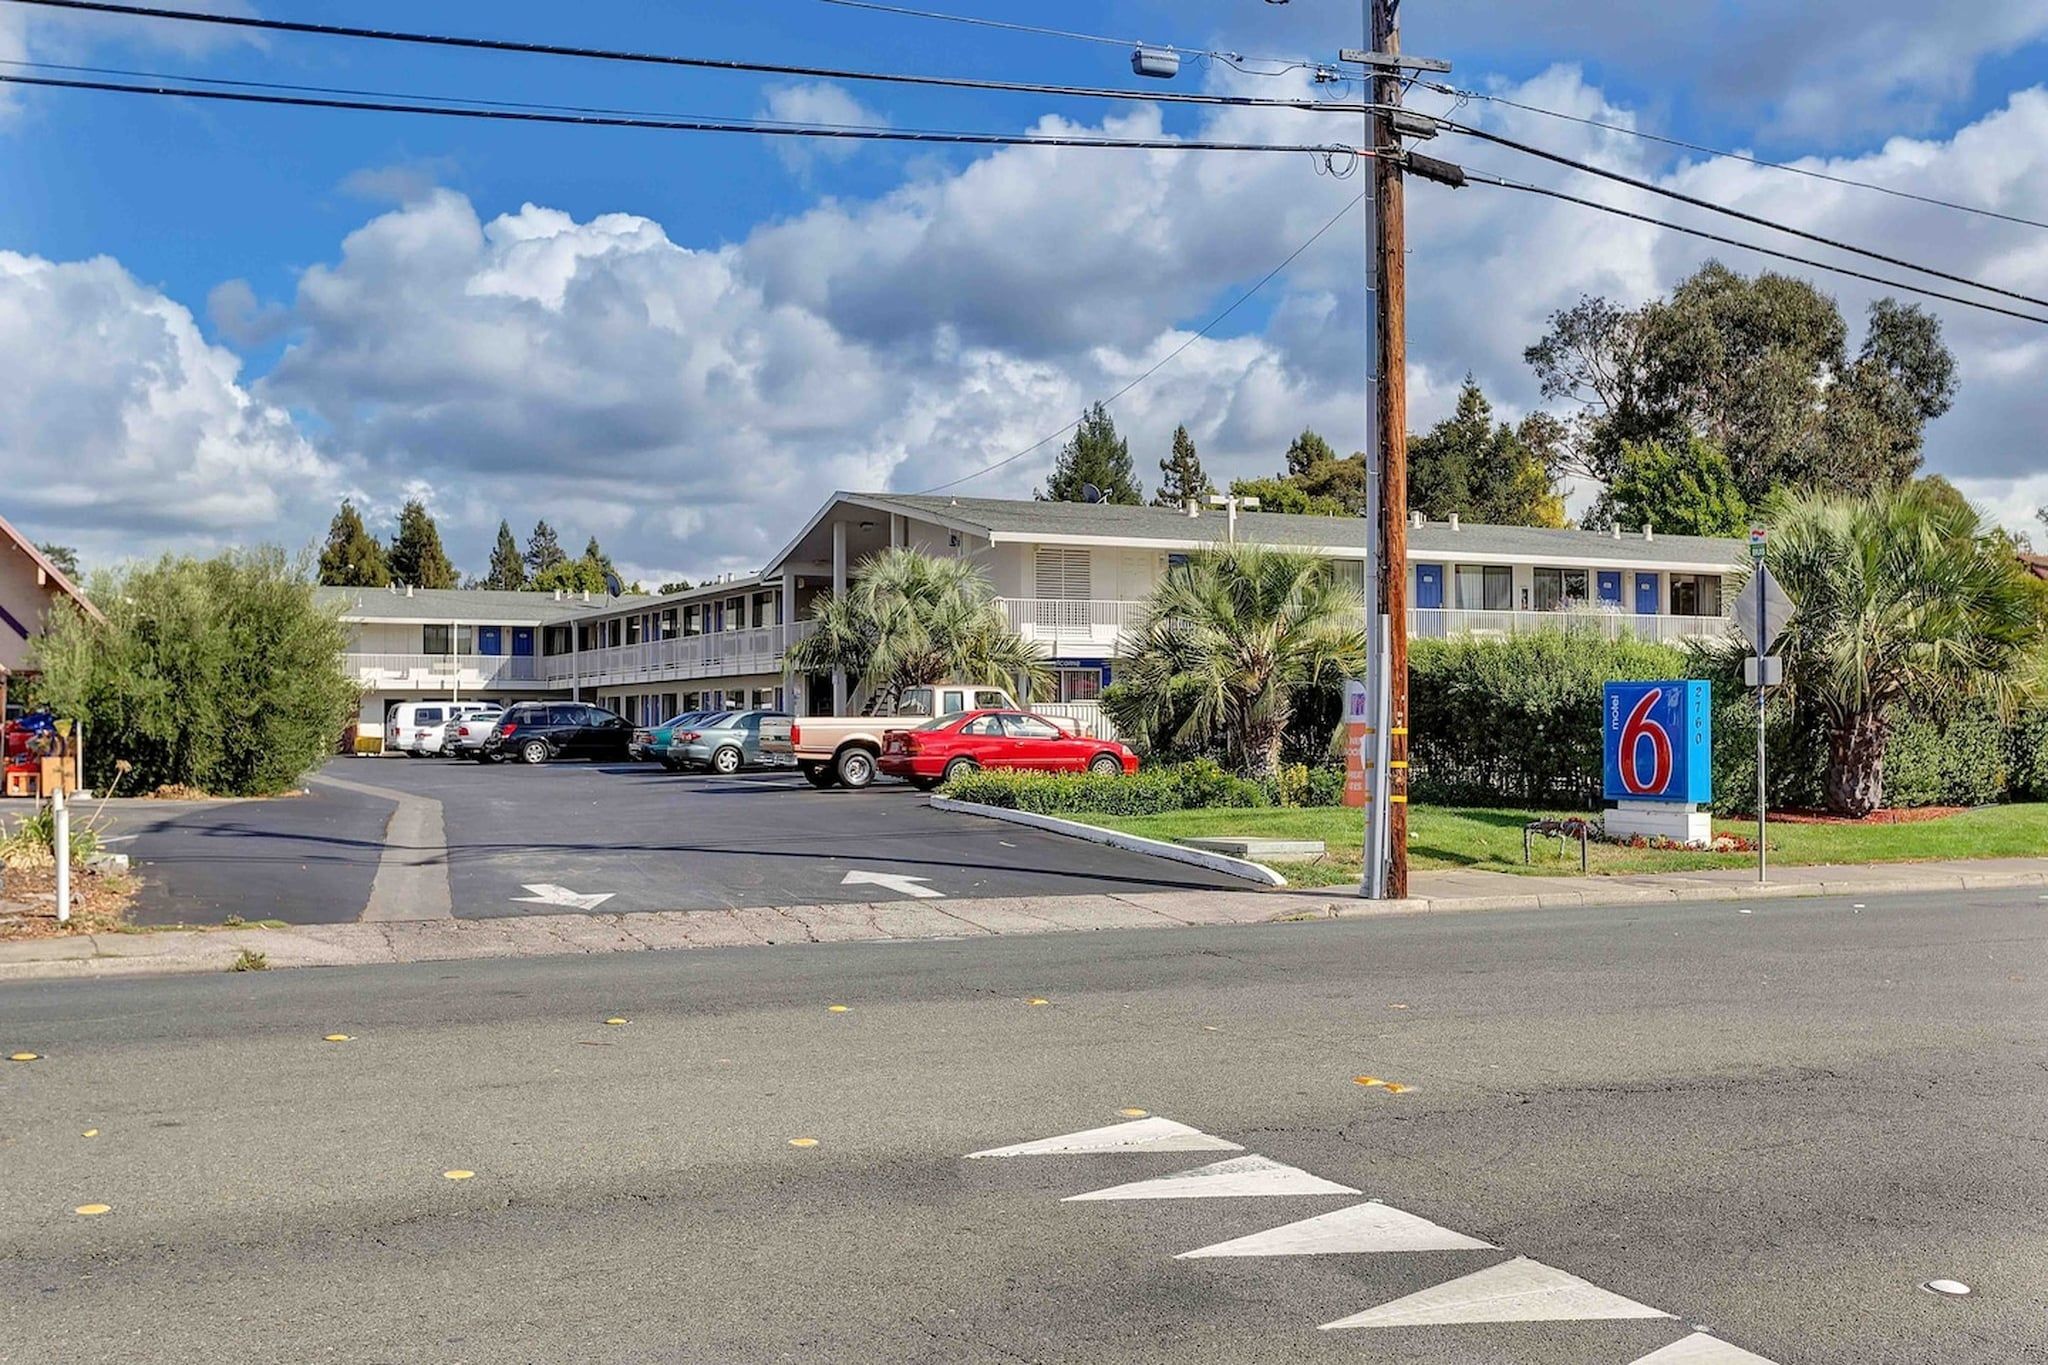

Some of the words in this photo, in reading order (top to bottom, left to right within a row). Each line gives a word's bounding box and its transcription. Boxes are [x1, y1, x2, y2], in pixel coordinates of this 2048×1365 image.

[1611, 694, 1620, 731] motel
[1618, 687, 1673, 795] 6
[1695, 686, 1703, 745] 2760
